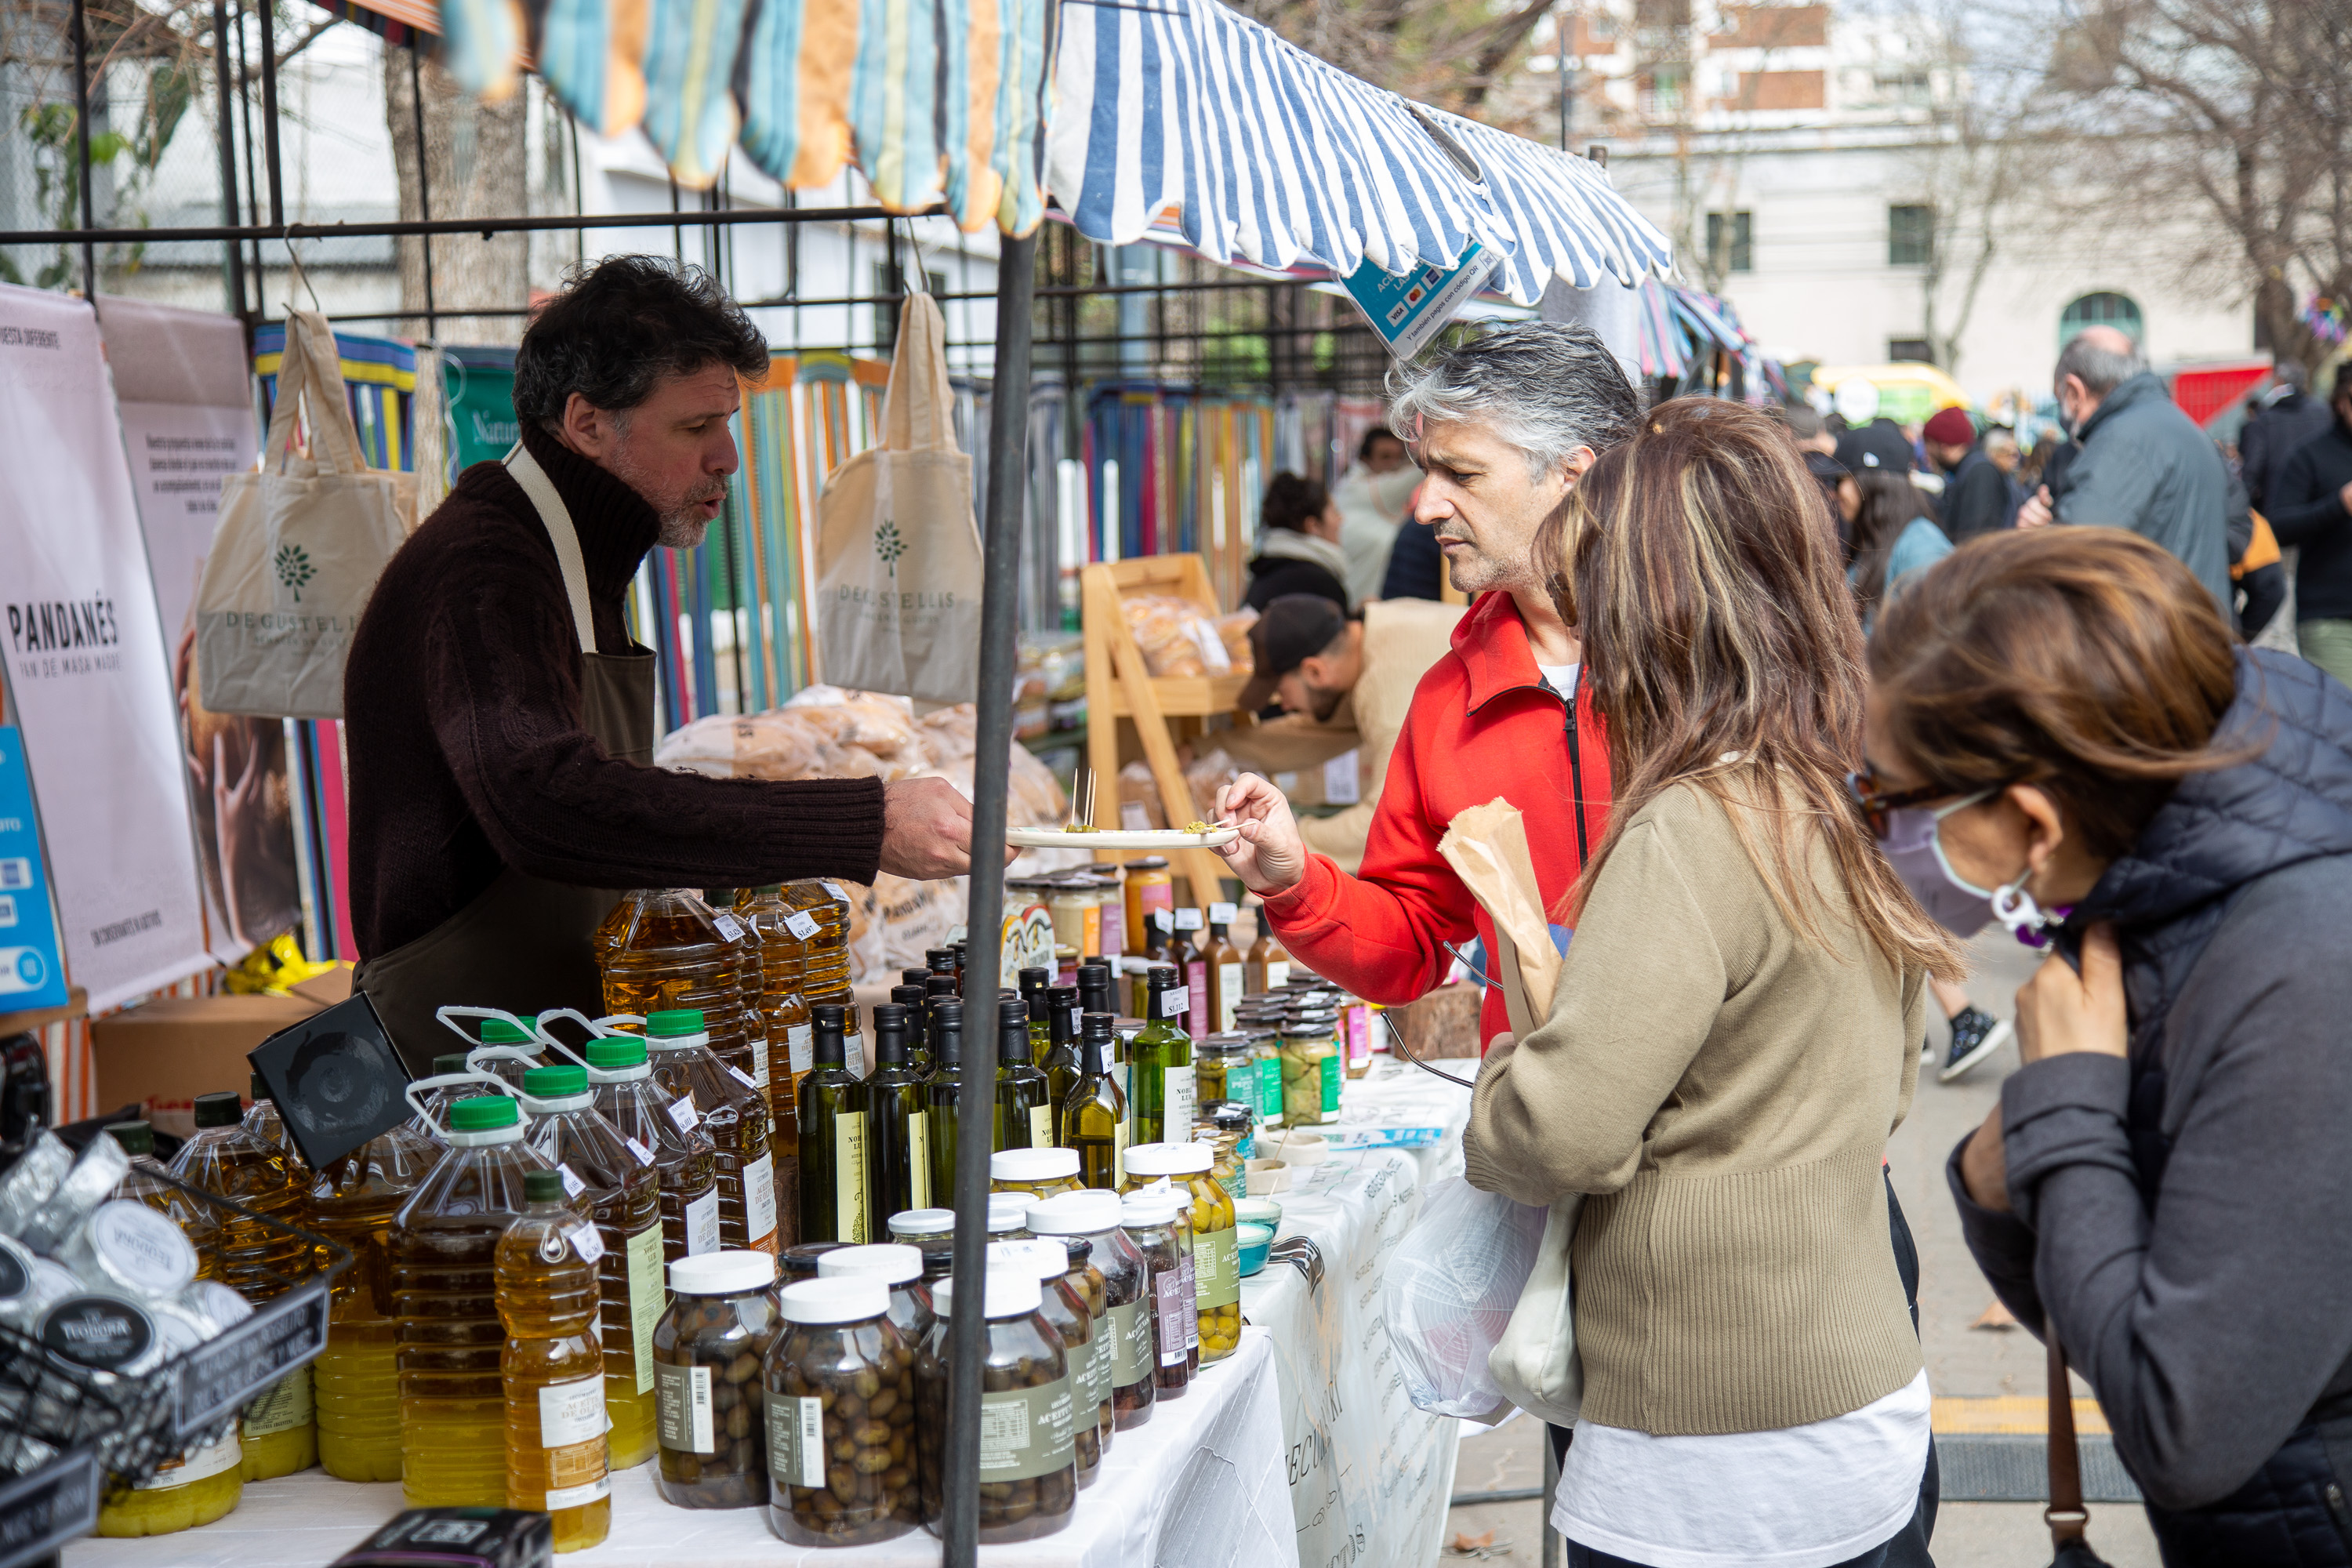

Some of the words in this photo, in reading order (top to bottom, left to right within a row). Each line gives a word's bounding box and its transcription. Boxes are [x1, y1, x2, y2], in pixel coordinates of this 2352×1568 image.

[1411, 315, 1432, 337] también
[1430, 302, 1446, 319] pagos
[1445, 291, 1455, 303] con
[1454, 274, 1471, 293] código
[1468, 265, 1479, 275] QR
[1391, 306, 1405, 320] VISA
[7, 589, 118, 654] PANDANÉS
[797, 925, 815, 938] $1,497
[644, 1241, 658, 1255] NOBLE
[648, 1252, 657, 1263] LUR
[561, 1409, 577, 1419] DE
[251, 1421, 273, 1432] INDUSTRIA
[273, 1418, 293, 1428] ARGENTINA
